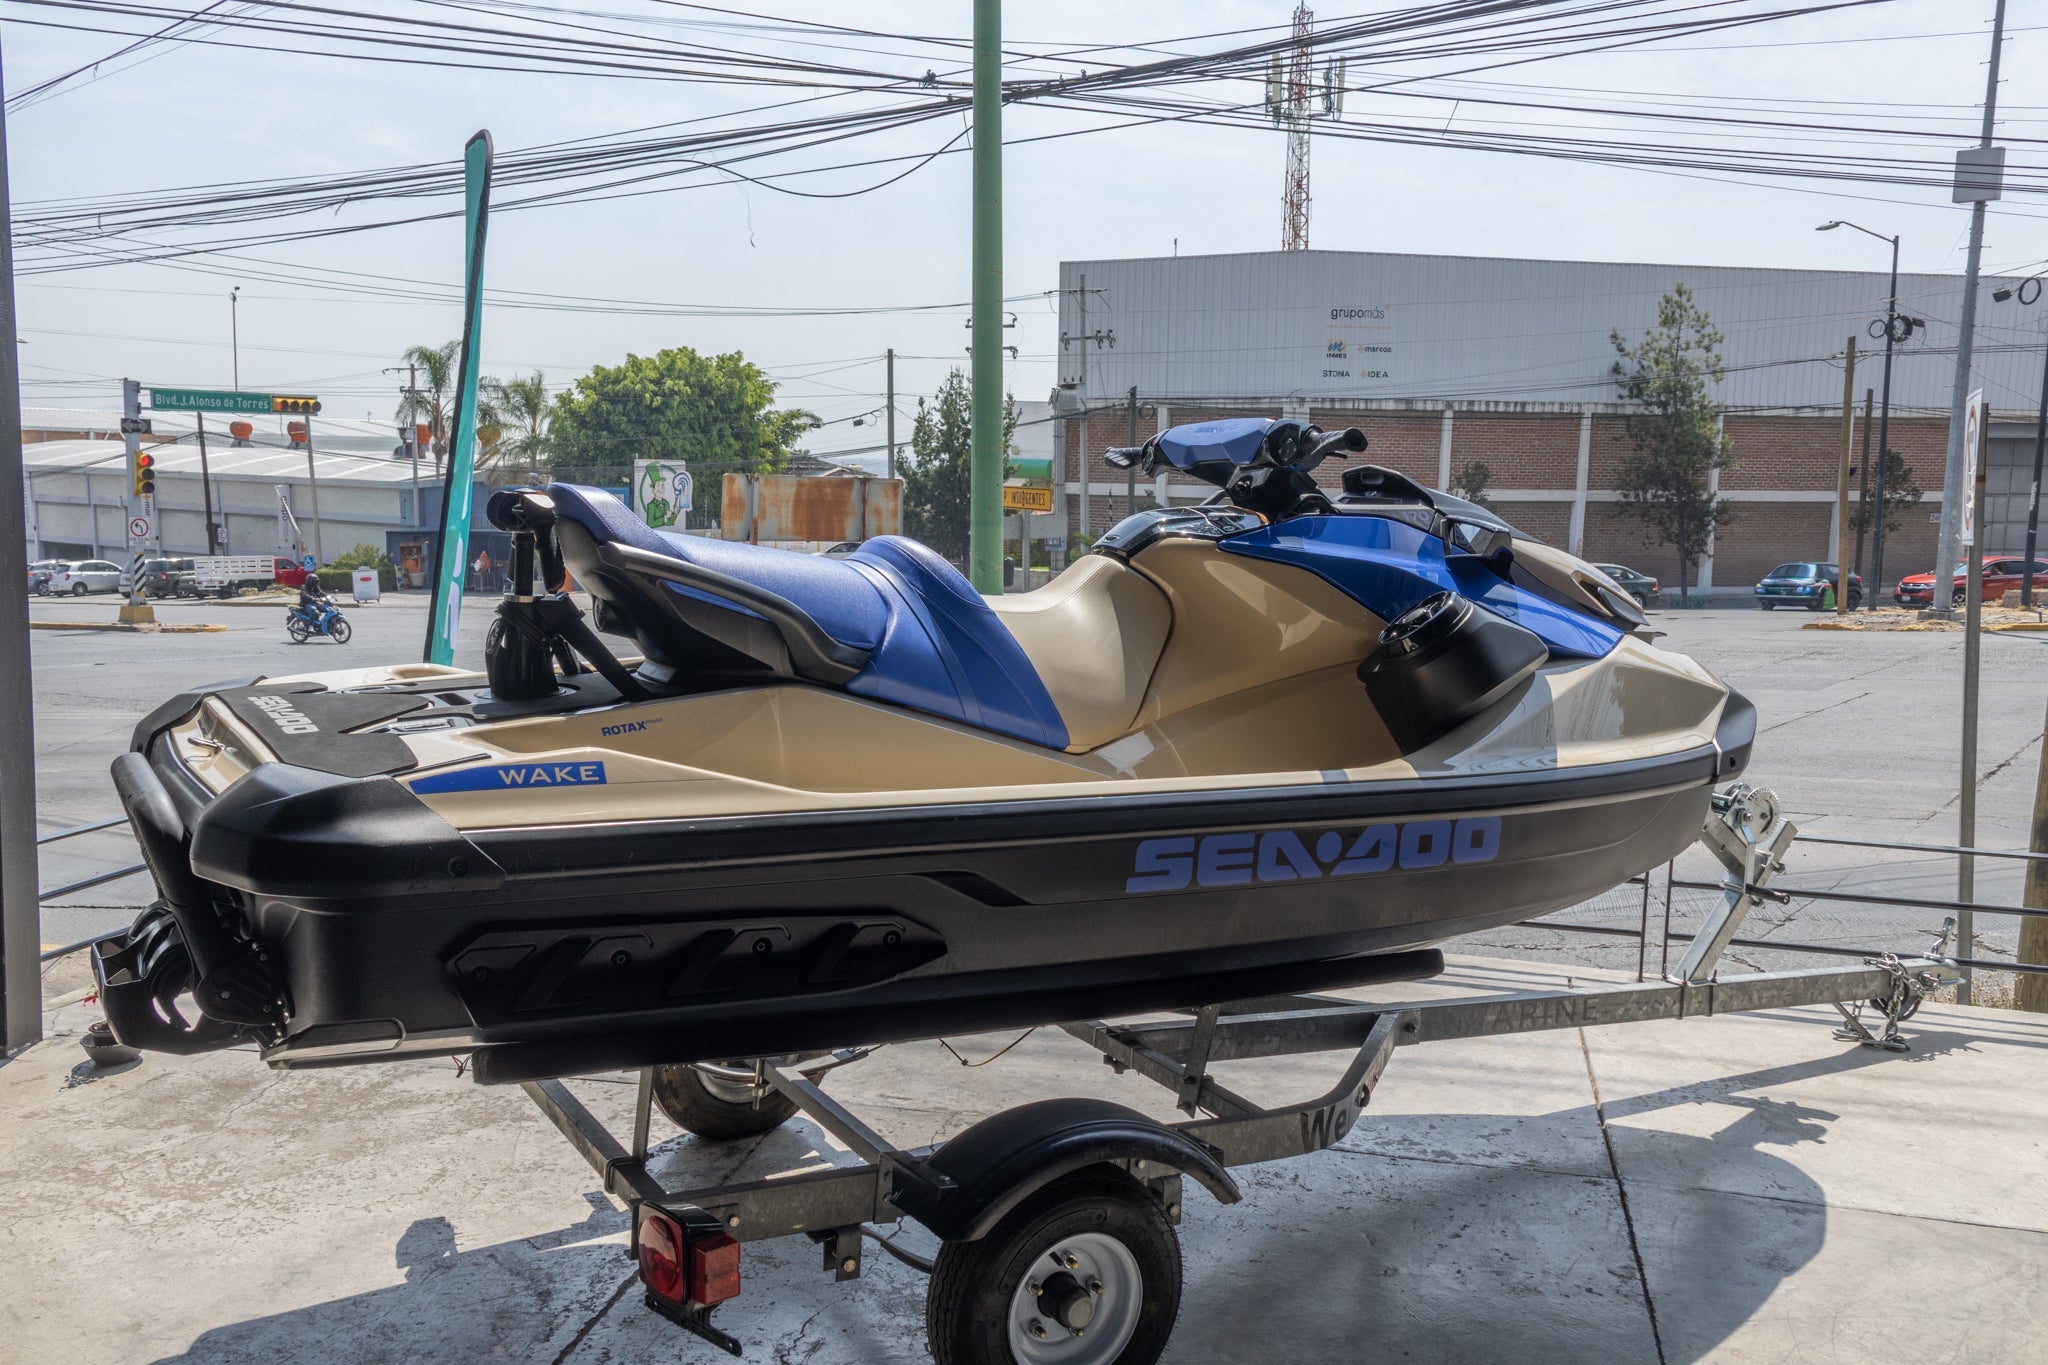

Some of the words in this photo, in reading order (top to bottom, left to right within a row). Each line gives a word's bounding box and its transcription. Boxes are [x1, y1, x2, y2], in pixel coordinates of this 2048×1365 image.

[155, 393, 179, 406] Blvd.
[188, 394, 221, 408] Alonso
[223, 397, 234, 408] de
[236, 397, 269, 409] Torres
[1402, 510, 1430, 522] 170
[601, 721, 647, 737] ROTAX
[498, 765, 600, 785] WAKE
